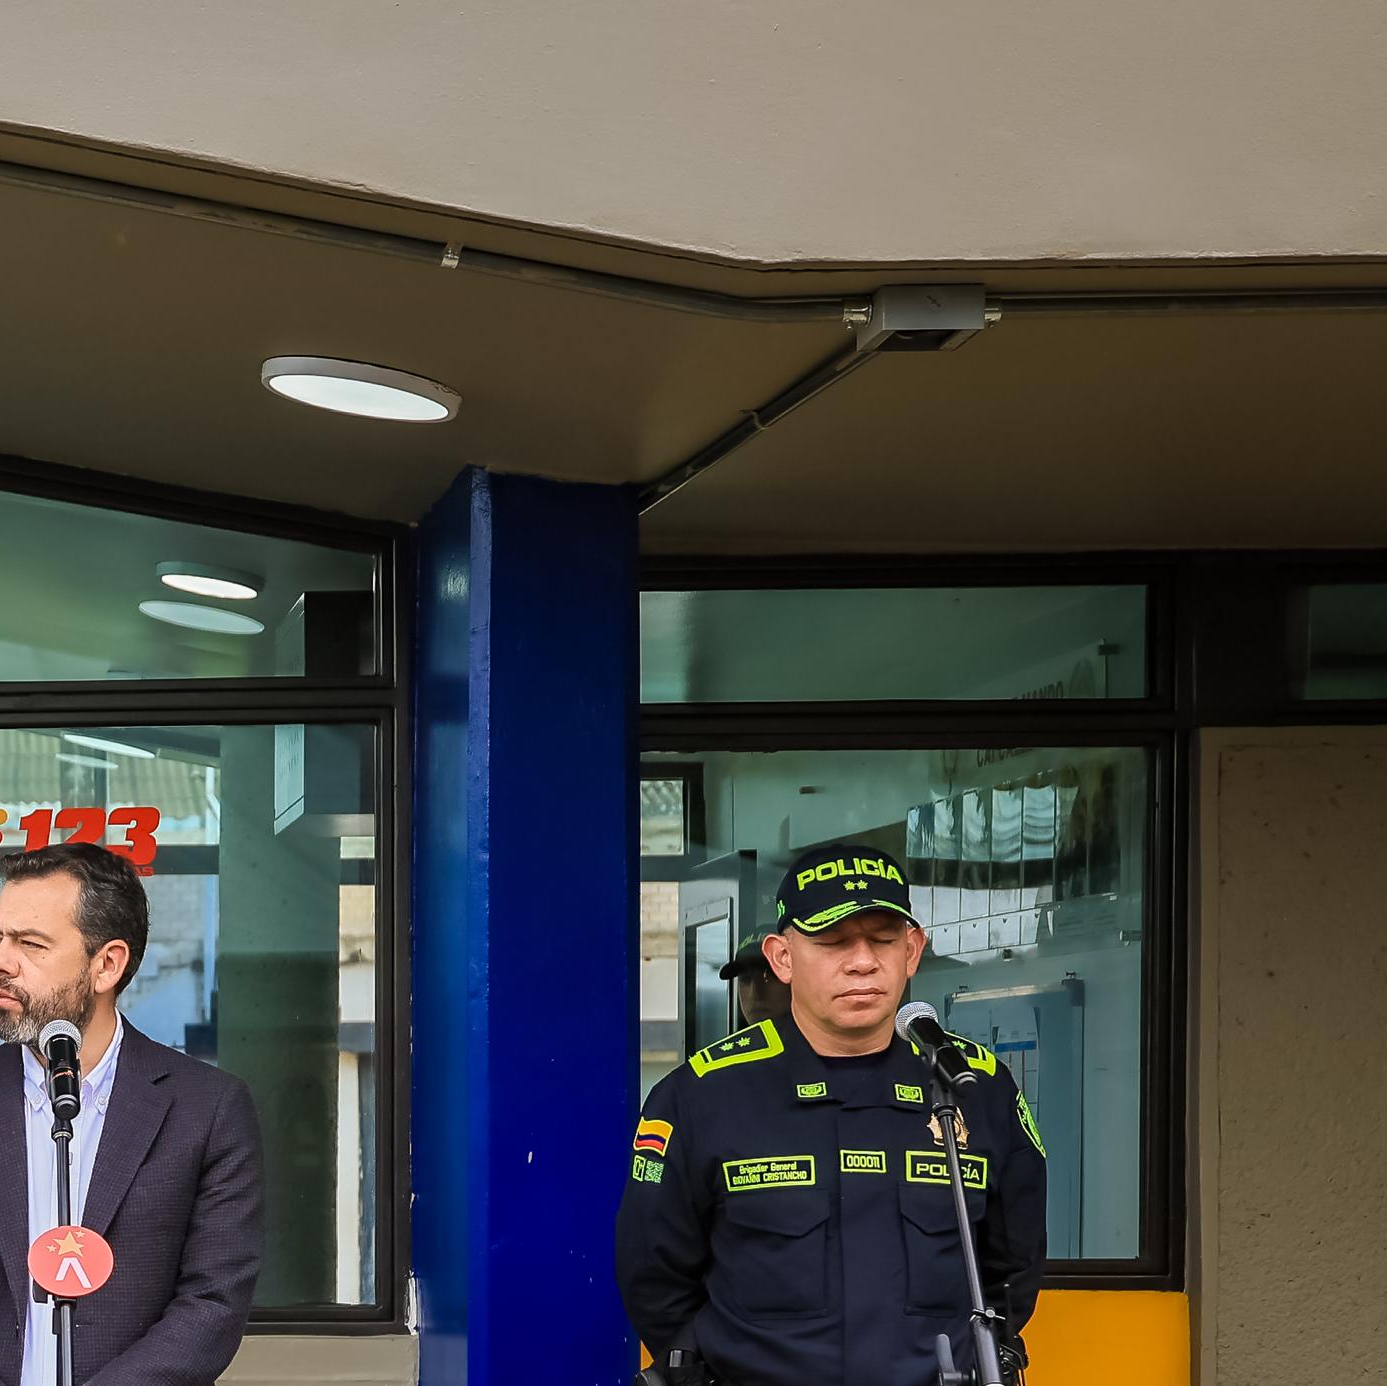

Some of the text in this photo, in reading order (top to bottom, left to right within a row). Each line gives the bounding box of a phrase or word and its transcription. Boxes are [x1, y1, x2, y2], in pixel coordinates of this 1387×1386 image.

[18, 806, 162, 867] 123
[796, 857, 904, 892] POLICÍA
[846, 1154, 881, 1169] 000011
[916, 1161, 980, 1181] POLÍA
